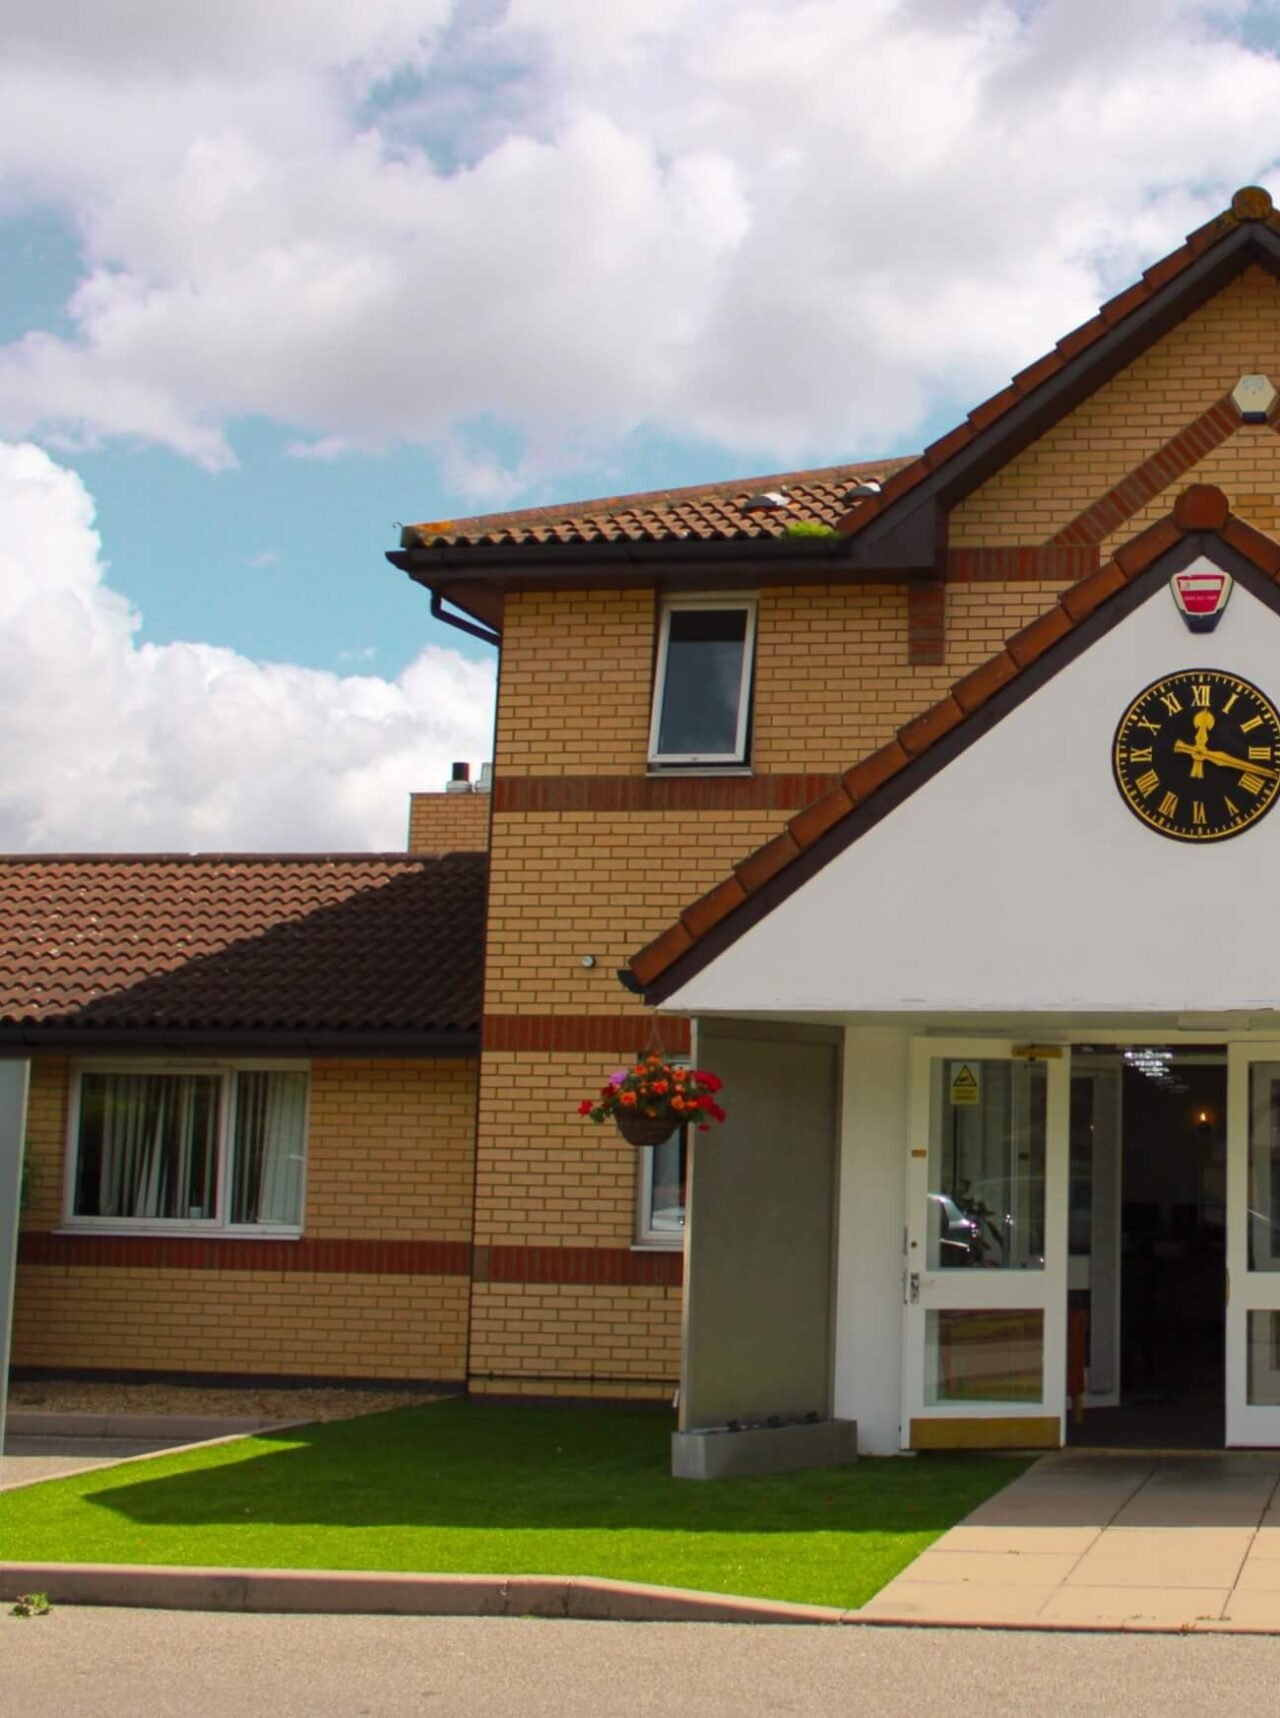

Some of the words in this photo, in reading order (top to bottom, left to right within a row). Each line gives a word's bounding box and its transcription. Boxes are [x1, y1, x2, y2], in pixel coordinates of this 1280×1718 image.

[1160, 692, 1183, 717] XI
[1191, 685, 1211, 707] XII
[1222, 693, 1239, 714] I
[1137, 714, 1162, 735] X
[1240, 715, 1263, 733] II
[1130, 746, 1152, 762] IX
[1248, 746, 1271, 760] III
[1135, 769, 1160, 798] VIII
[1158, 792, 1180, 819] VII
[1192, 801, 1207, 824] VI
[1224, 795, 1240, 817] V
